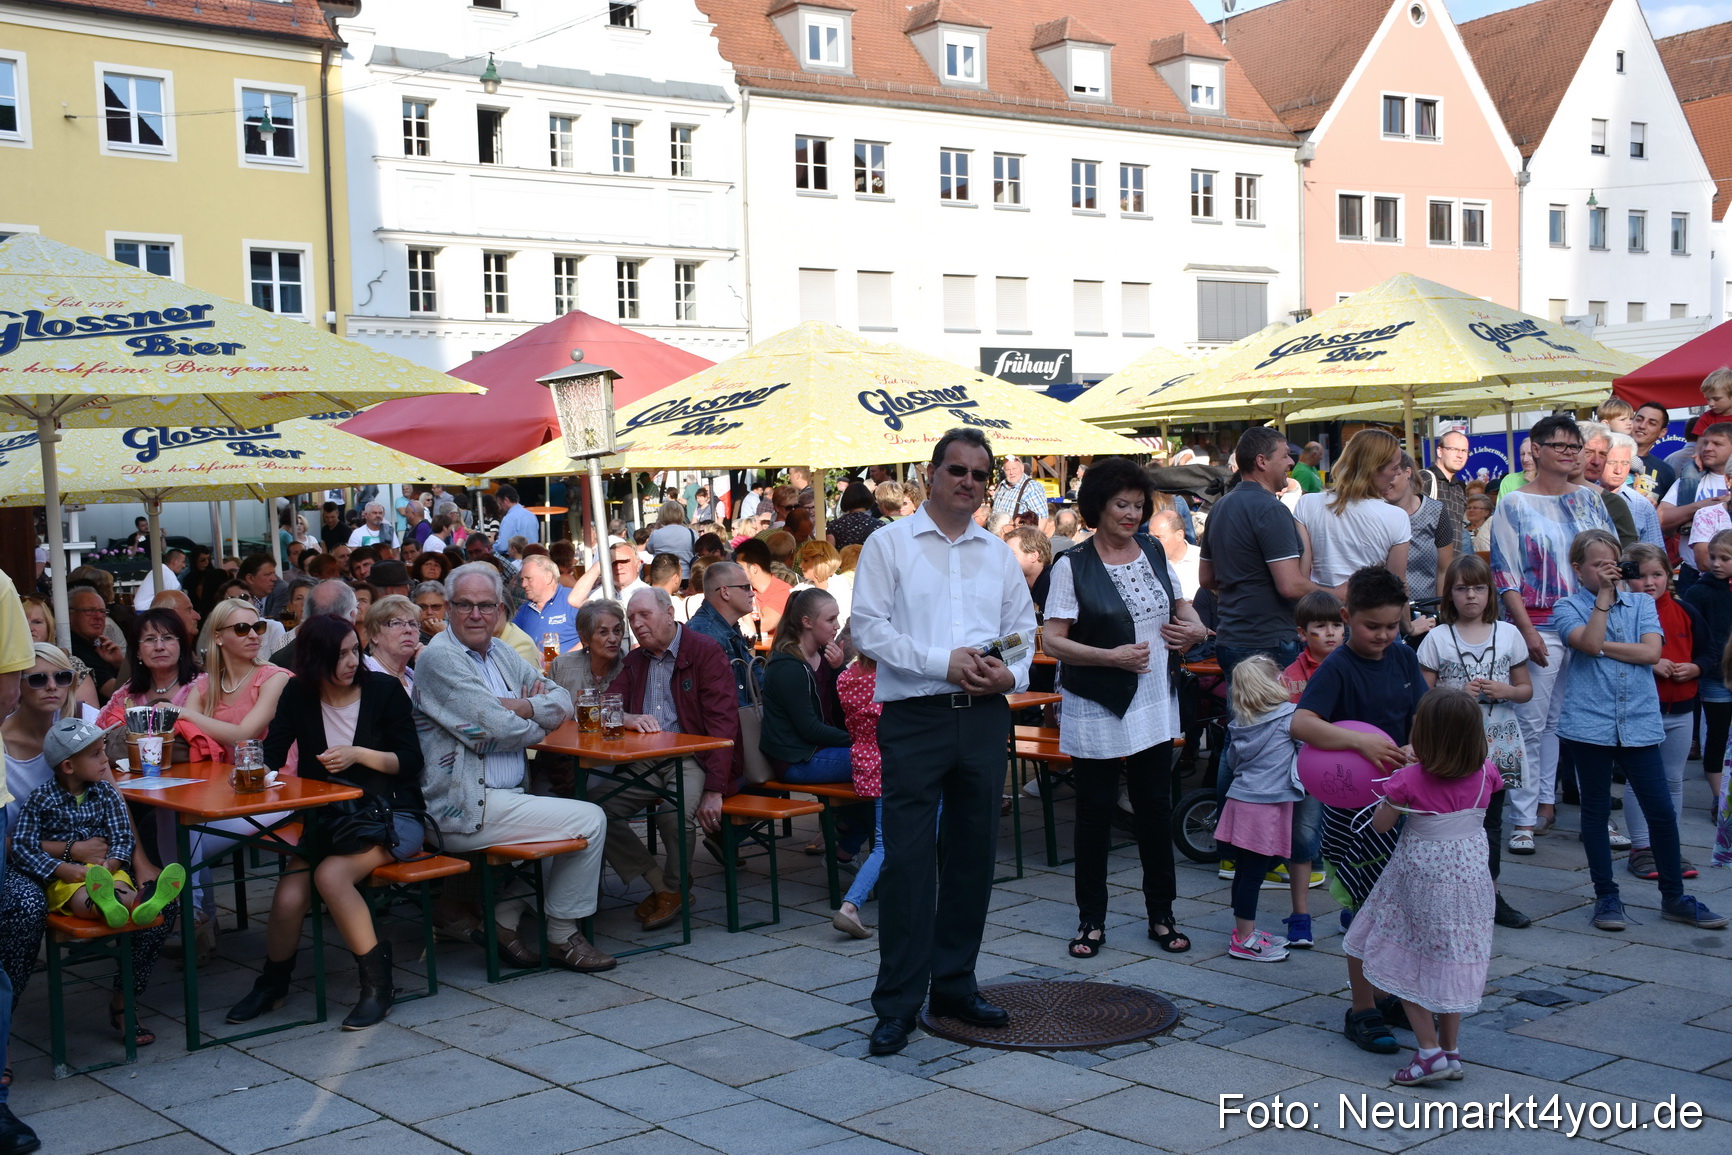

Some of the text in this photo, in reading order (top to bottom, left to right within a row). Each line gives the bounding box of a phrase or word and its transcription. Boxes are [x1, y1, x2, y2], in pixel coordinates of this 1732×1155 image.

[44, 296, 126, 309] Seit 1574
[125, 333, 247, 357] Bier
[1254, 320, 1416, 371] Glossner
[1317, 346, 1388, 363] Bier
[22, 361, 153, 378] hochfeine
[164, 359, 310, 377] Biergenuss
[992, 350, 1070, 381] frühauf
[616, 382, 791, 438] Glossner
[857, 384, 970, 431] Glossner
[668, 414, 744, 437] Bier
[948, 408, 1013, 430] Bier
[226, 441, 306, 460] Bier
[121, 460, 353, 475] Der hochfeine Biergenuss
